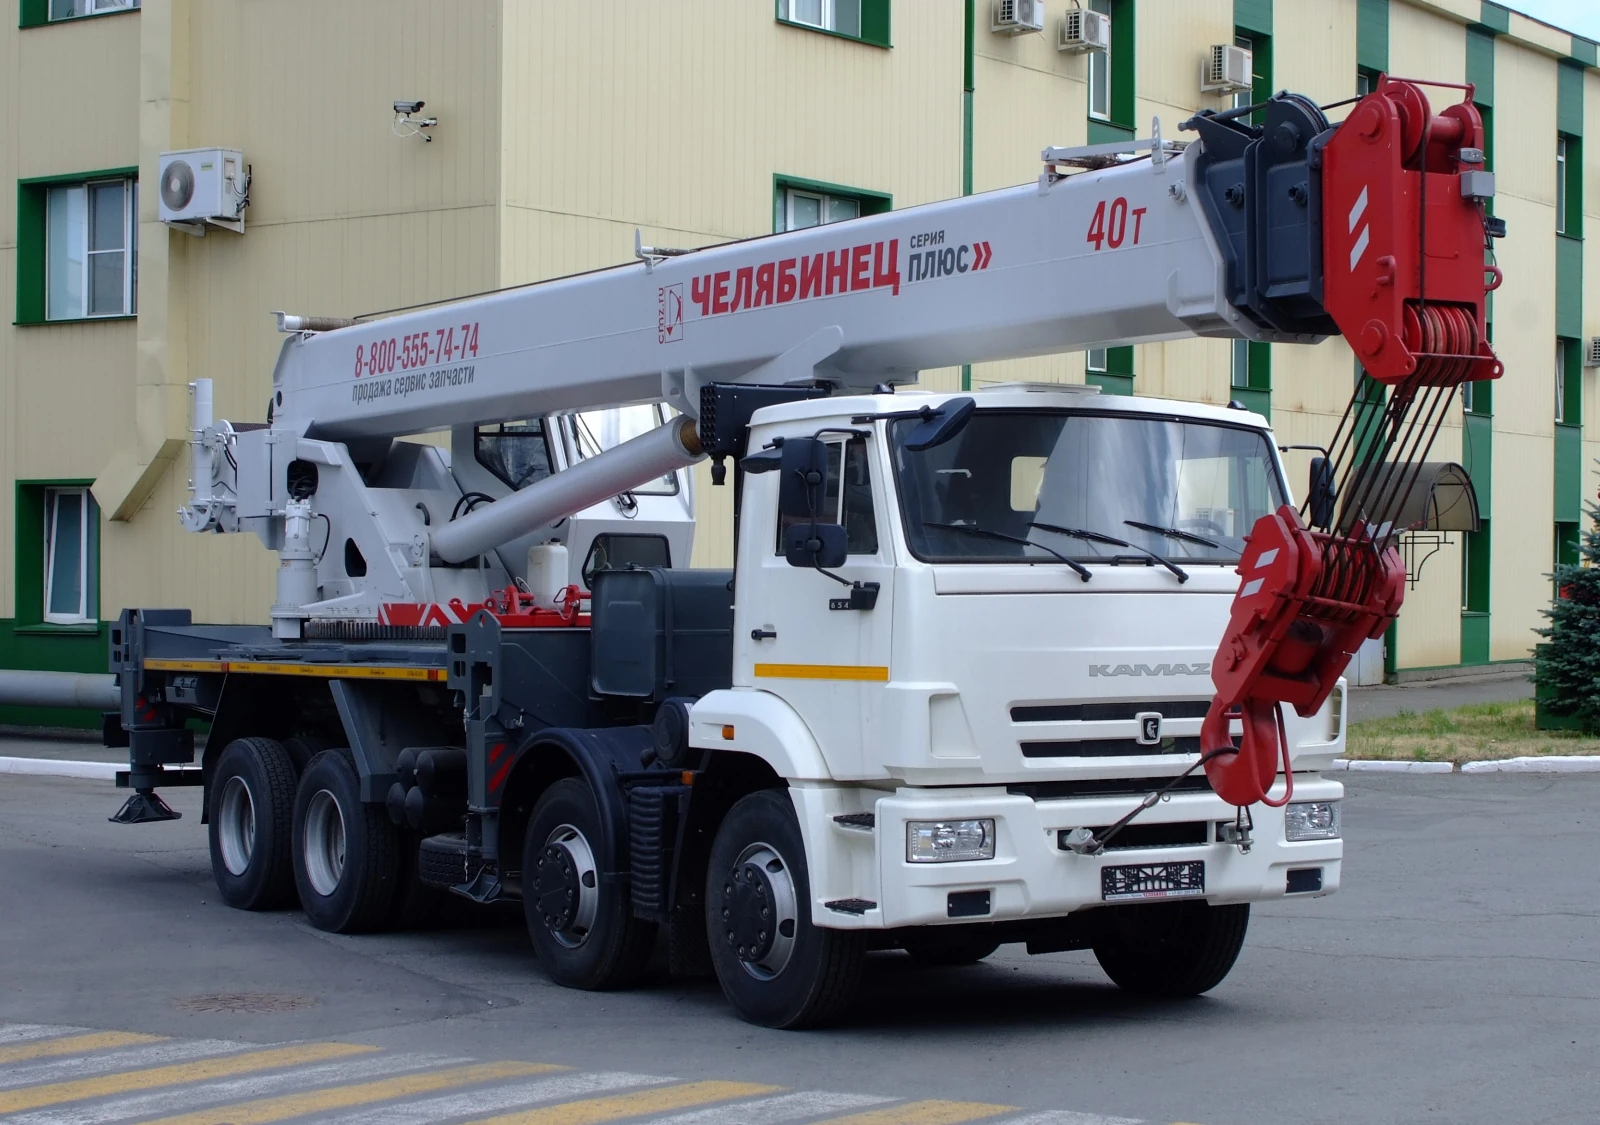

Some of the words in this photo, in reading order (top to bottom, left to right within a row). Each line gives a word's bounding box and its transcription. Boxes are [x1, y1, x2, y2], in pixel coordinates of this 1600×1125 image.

[910, 230, 945, 249] СЕРИЯ
[691, 238, 900, 316] ЧЕЛЯБИНЕЦ
[908, 244, 969, 282] ПЛЮС
[354, 322, 479, 378] 8-800-555-74-74
[352, 379, 392, 405] продажа
[393, 372, 427, 397] сервис
[428, 365, 475, 389] запчасти
[1088, 663, 1211, 677] KAMAZ
